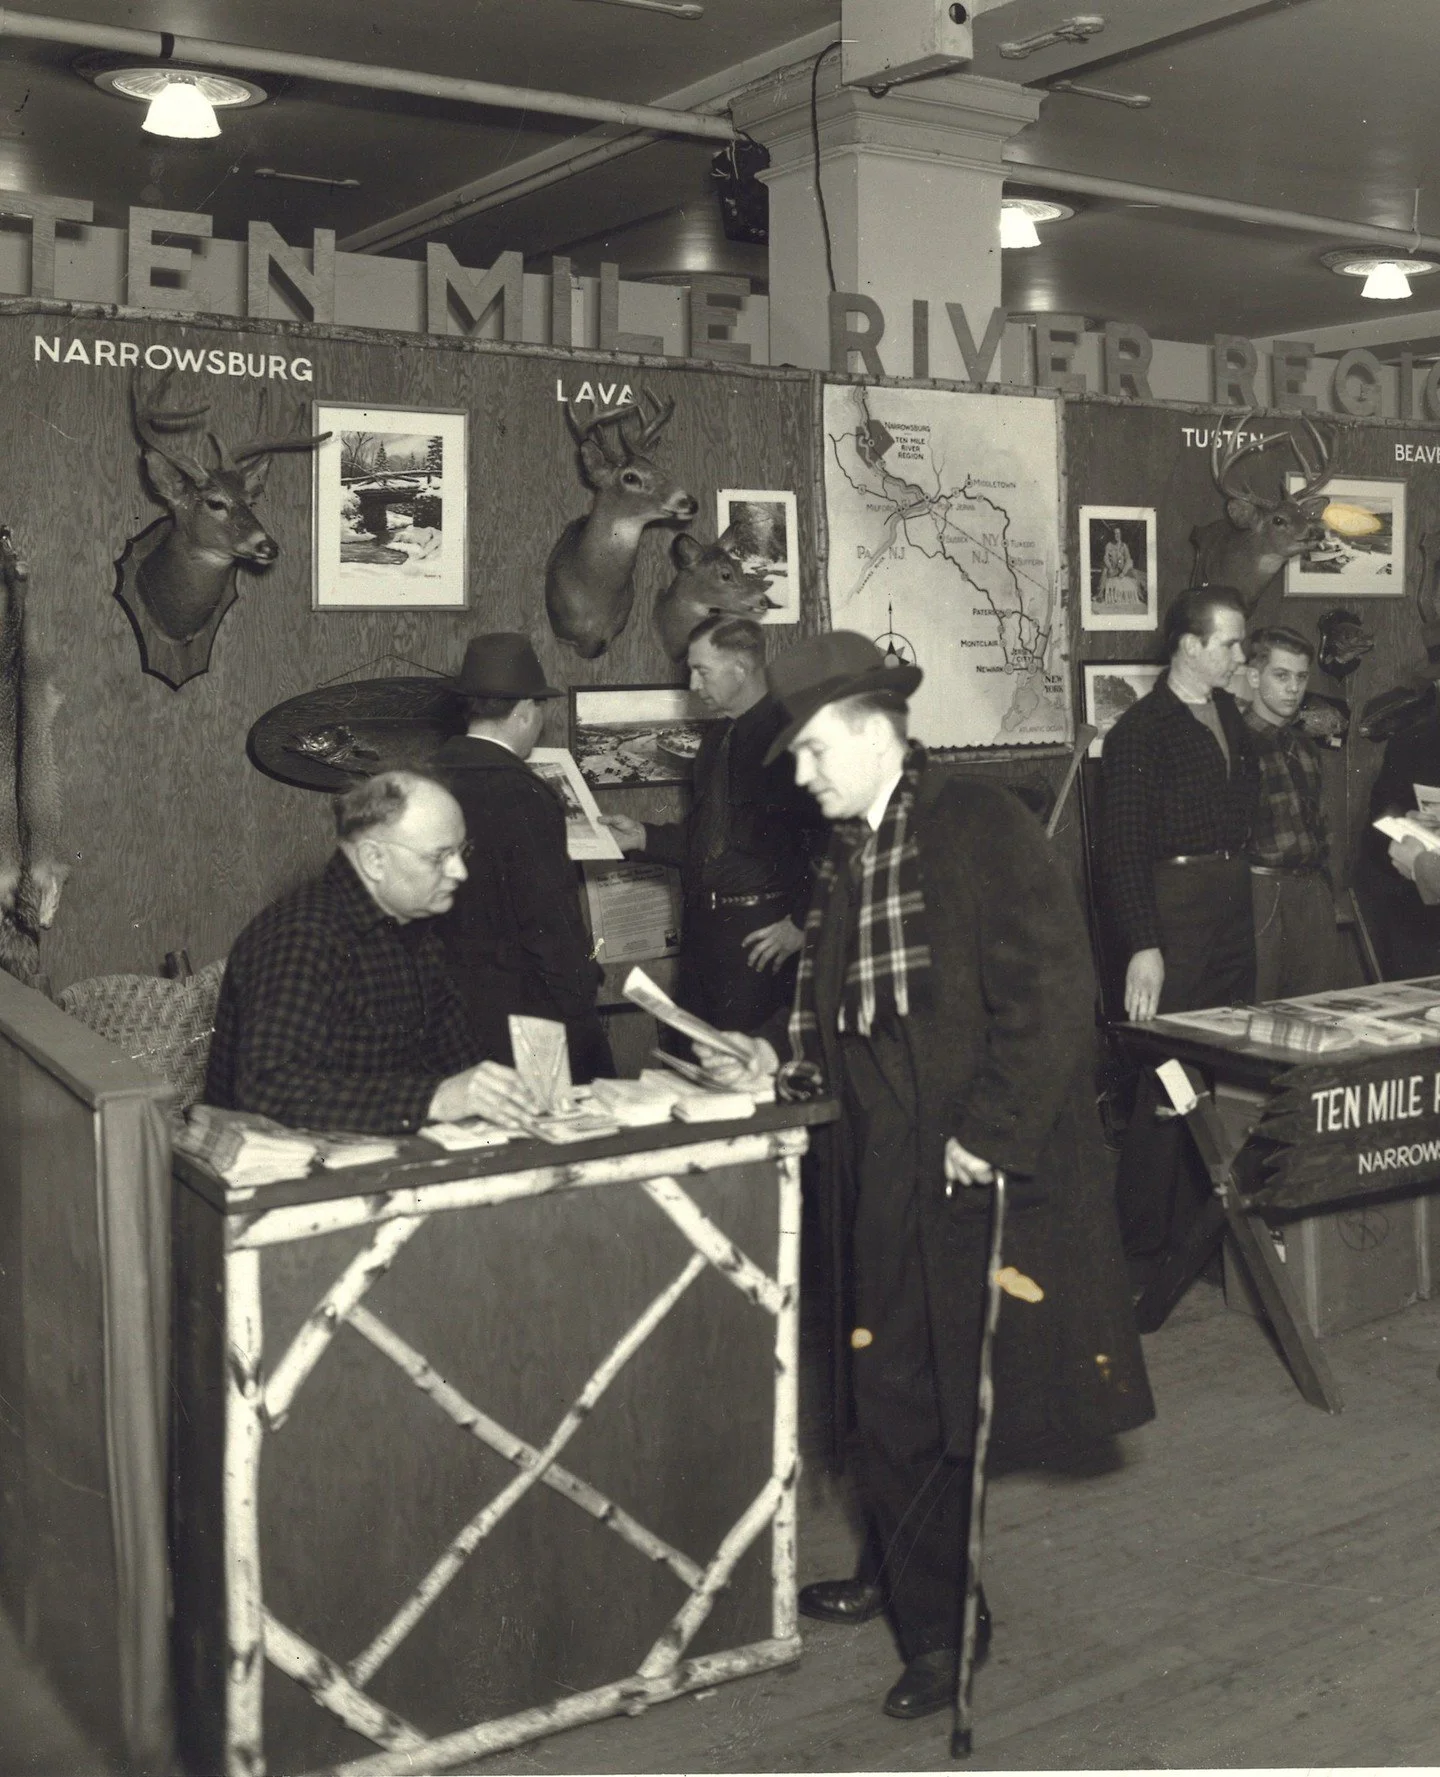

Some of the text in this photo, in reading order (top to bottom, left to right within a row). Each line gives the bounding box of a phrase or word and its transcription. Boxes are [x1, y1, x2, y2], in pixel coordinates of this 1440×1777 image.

[0, 190, 1440, 421] TEN MILE RIVER REGI
[34, 335, 313, 382] NARROWSBURG
[556, 379, 634, 406] LAVA
[884, 421, 931, 432] NARROWSBURG
[895, 436, 909, 444] TEN
[901, 444, 921, 452] RIVER
[898, 452, 924, 460] REGION
[973, 479, 1017, 489] MIDDLETOWN
[960, 640, 998, 648] MONTCLAIR
[976, 665, 1004, 673] NEWARK
[1044, 675, 1063, 684] NEW
[1044, 685, 1064, 693] YORK
[1311, 1083, 1361, 1134] TEN
[1368, 1076, 1424, 1124] MILE
[1358, 1141, 1440, 1175] NARROW
